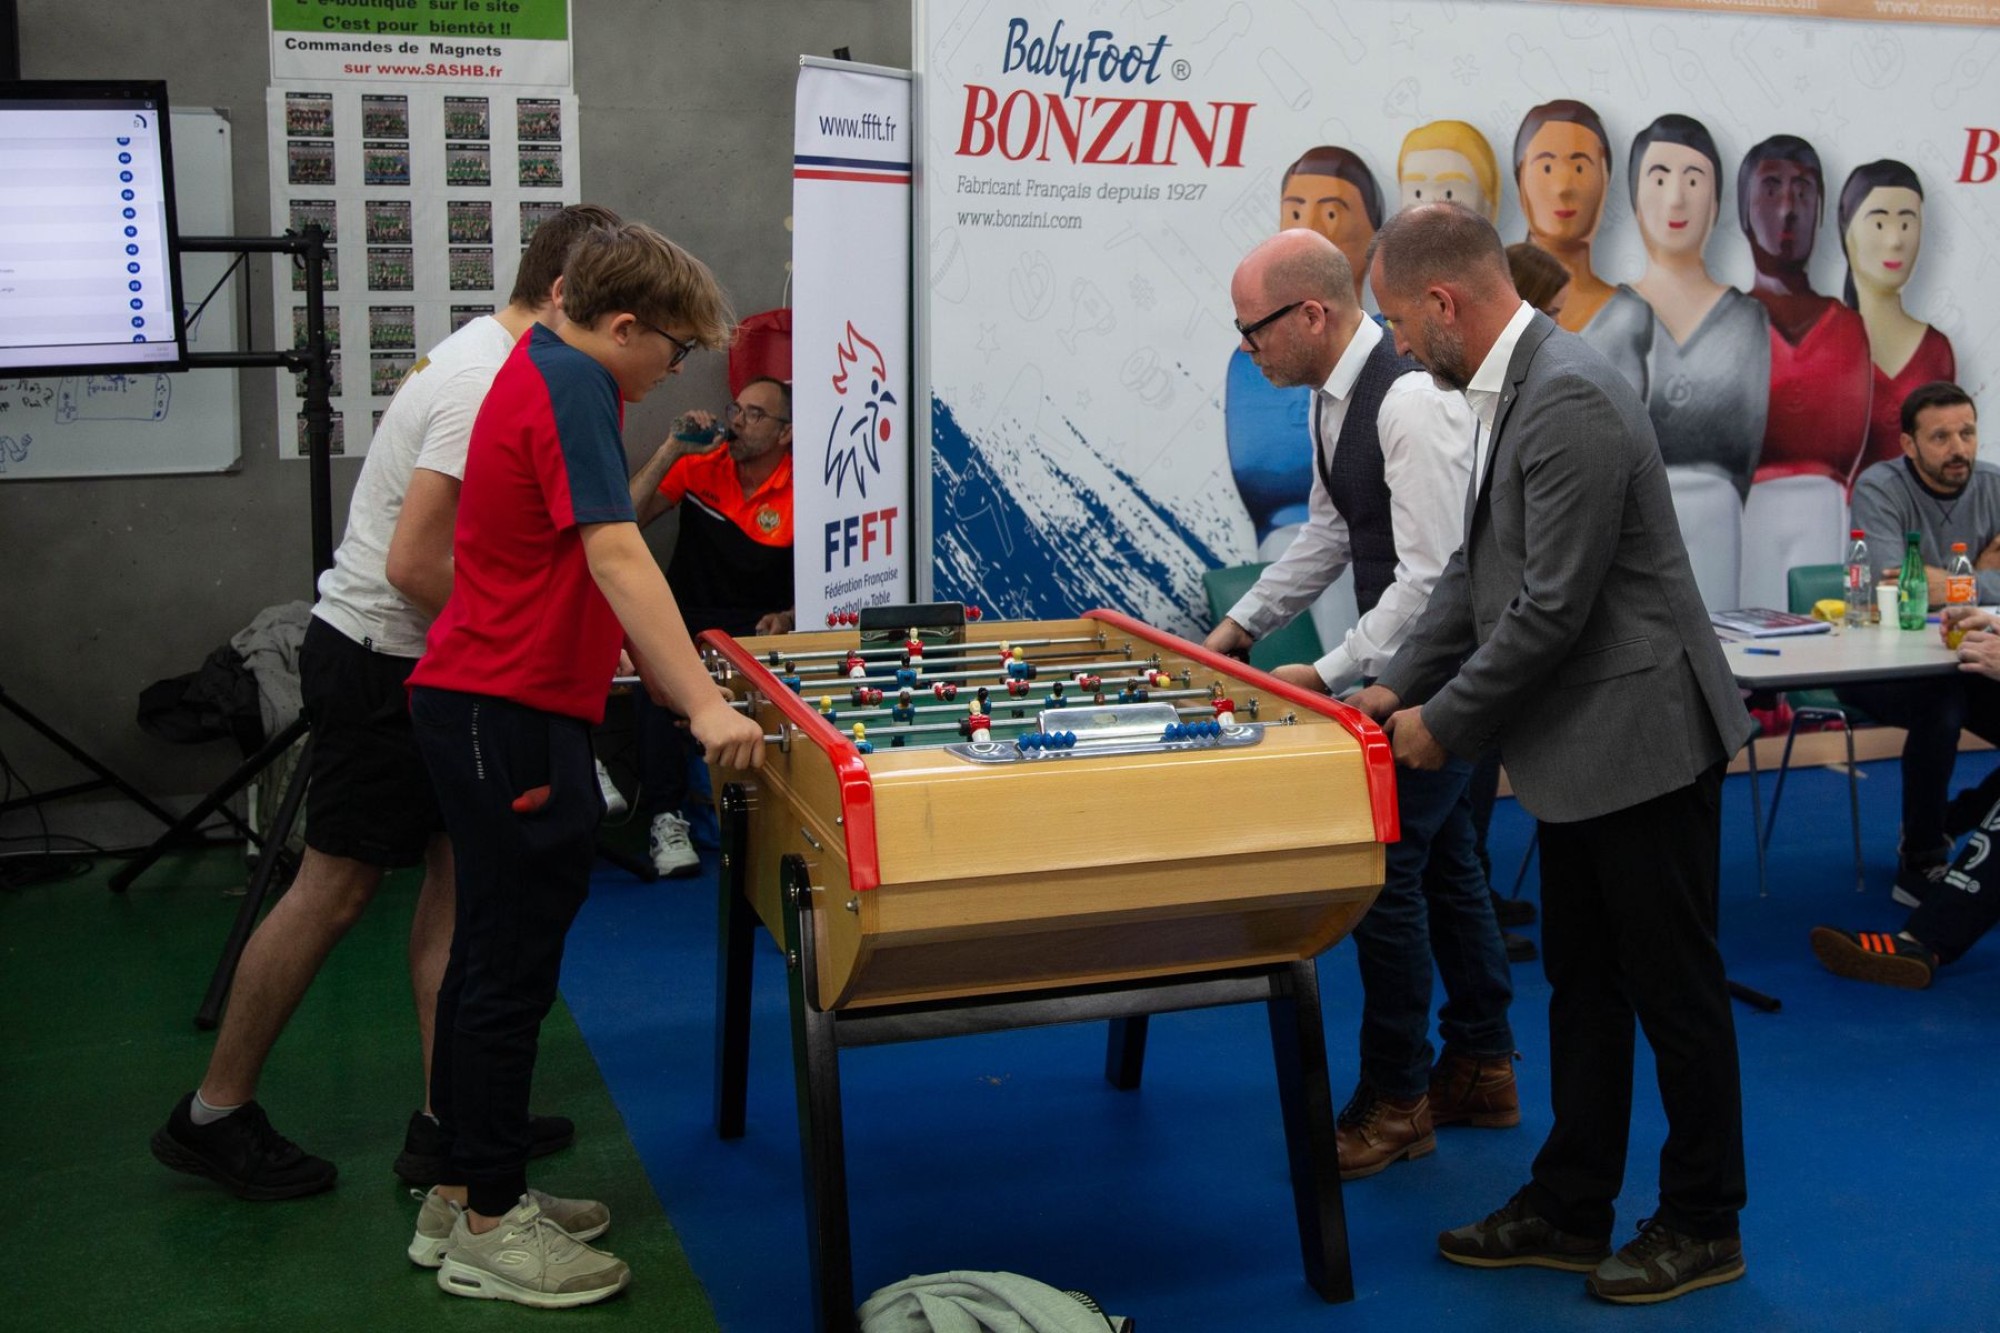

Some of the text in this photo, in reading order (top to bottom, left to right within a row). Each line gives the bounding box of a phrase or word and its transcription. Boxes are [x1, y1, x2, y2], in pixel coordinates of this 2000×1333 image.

[430, 0, 457, 10] sur
[464, 0, 480, 11] le
[486, 0, 520, 13] site
[377, 20, 419, 34] pour
[429, 20, 495, 35] bientôt
[285, 37, 502, 58] Commandes de Magnets
[1003, 17, 1172, 99] BabyFoot
[344, 63, 503, 77] sur www.SASHB.fr
[819, 113, 897, 141] www.ffft.fr
[955, 84, 1257, 168] BONZINI
[957, 175, 1208, 204] Fabricant Français depuis 1927
[957, 209, 1083, 229] www.bonzini.com
[825, 506, 897, 573] FFFT
[825, 566, 898, 600] Fédération Française
[871, 590, 891, 607] Table
